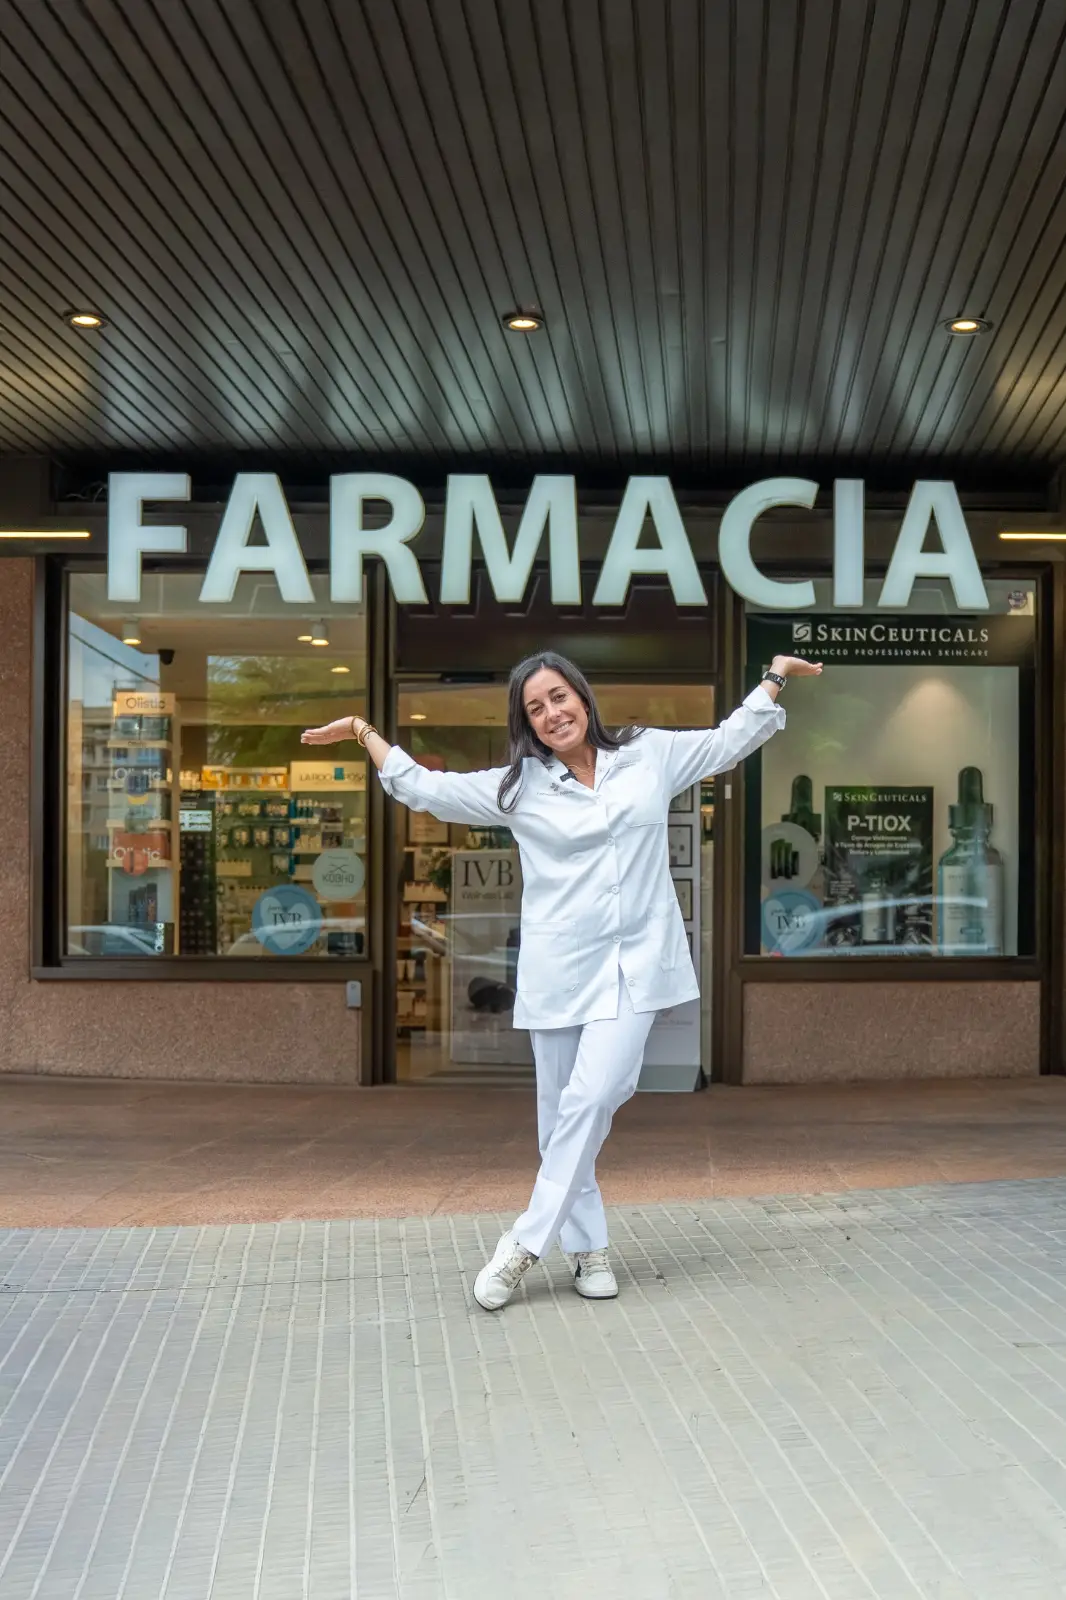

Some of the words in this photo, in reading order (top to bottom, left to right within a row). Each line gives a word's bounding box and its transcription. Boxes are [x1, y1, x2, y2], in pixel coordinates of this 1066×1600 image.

[107, 472, 991, 611] FARMACIA
[817, 624, 989, 643] SKINCEUTICALS
[793, 648, 849, 657] ADVANCED
[855, 648, 932, 657] PROFESSIONAL
[938, 648, 989, 657] SKINCARE
[125, 697, 166, 709] Olistic
[844, 792, 927, 803] SKINCEUTICALS
[847, 814, 912, 832] P-TIOX
[461, 859, 514, 887] IVB
[272, 912, 303, 927] IVB
